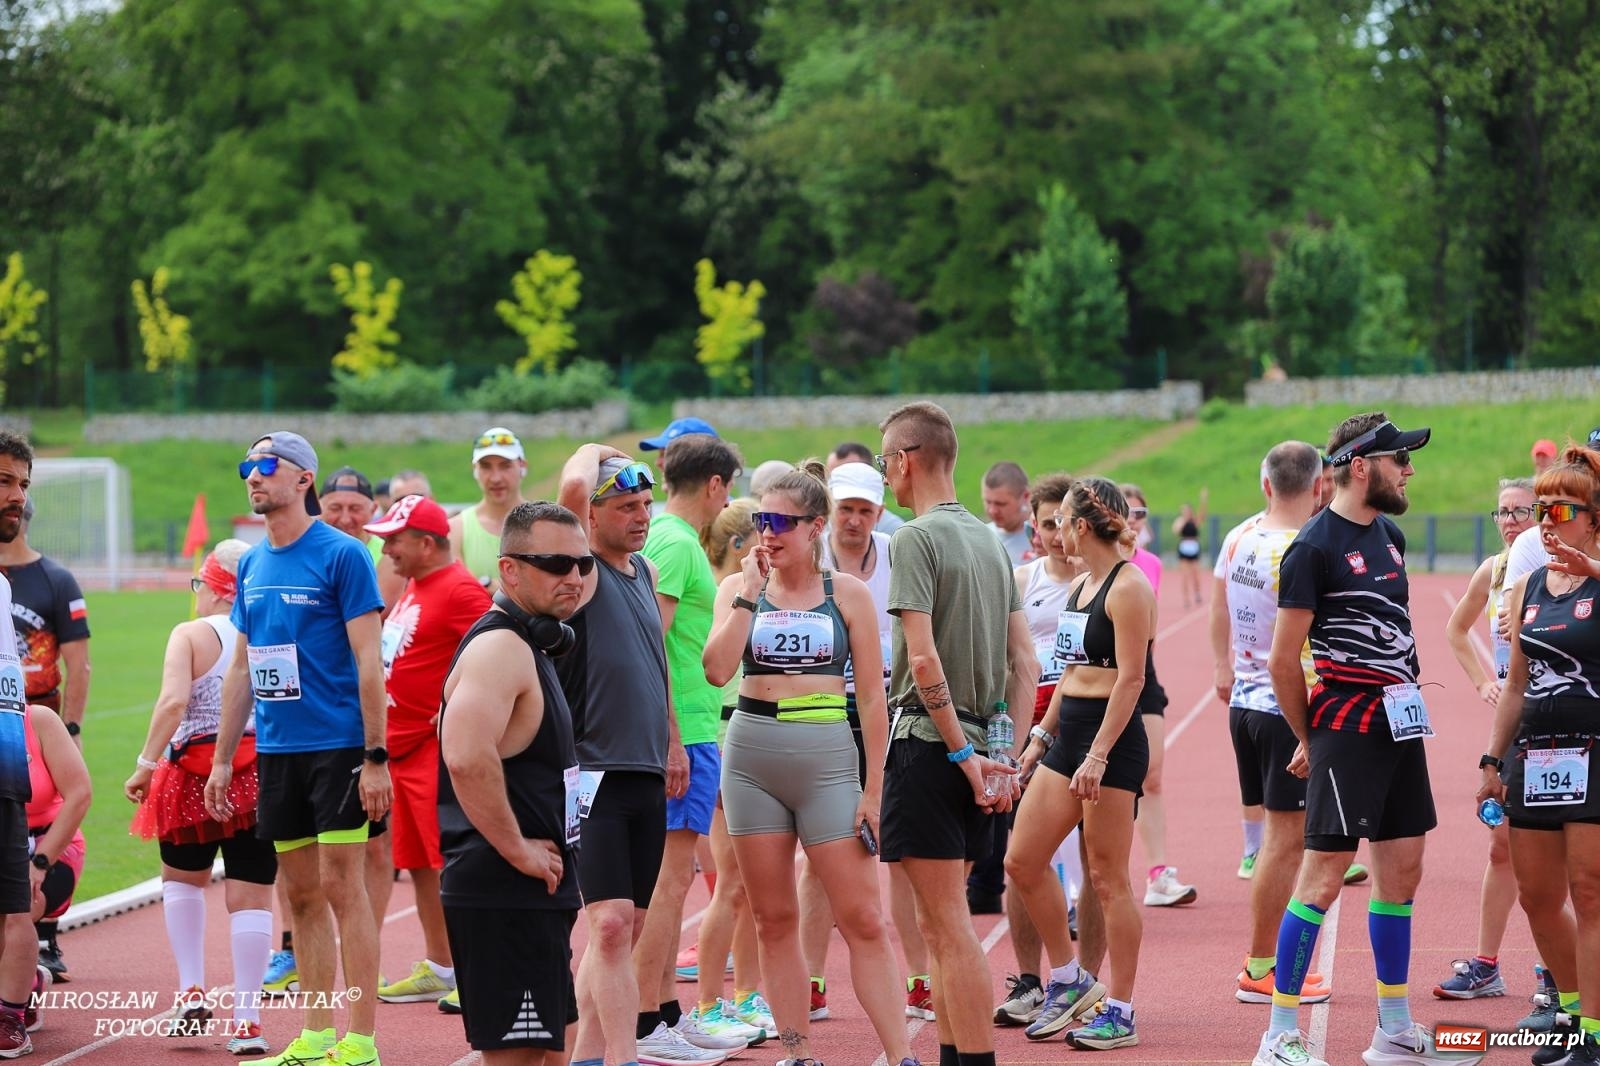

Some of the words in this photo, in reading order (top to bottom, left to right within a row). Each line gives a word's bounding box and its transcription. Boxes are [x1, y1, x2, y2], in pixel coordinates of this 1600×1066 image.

[774, 633, 811, 653] 231
[0, 676, 18, 698] 05
[256, 668, 280, 687] 175
[1541, 771, 1572, 790] 194
